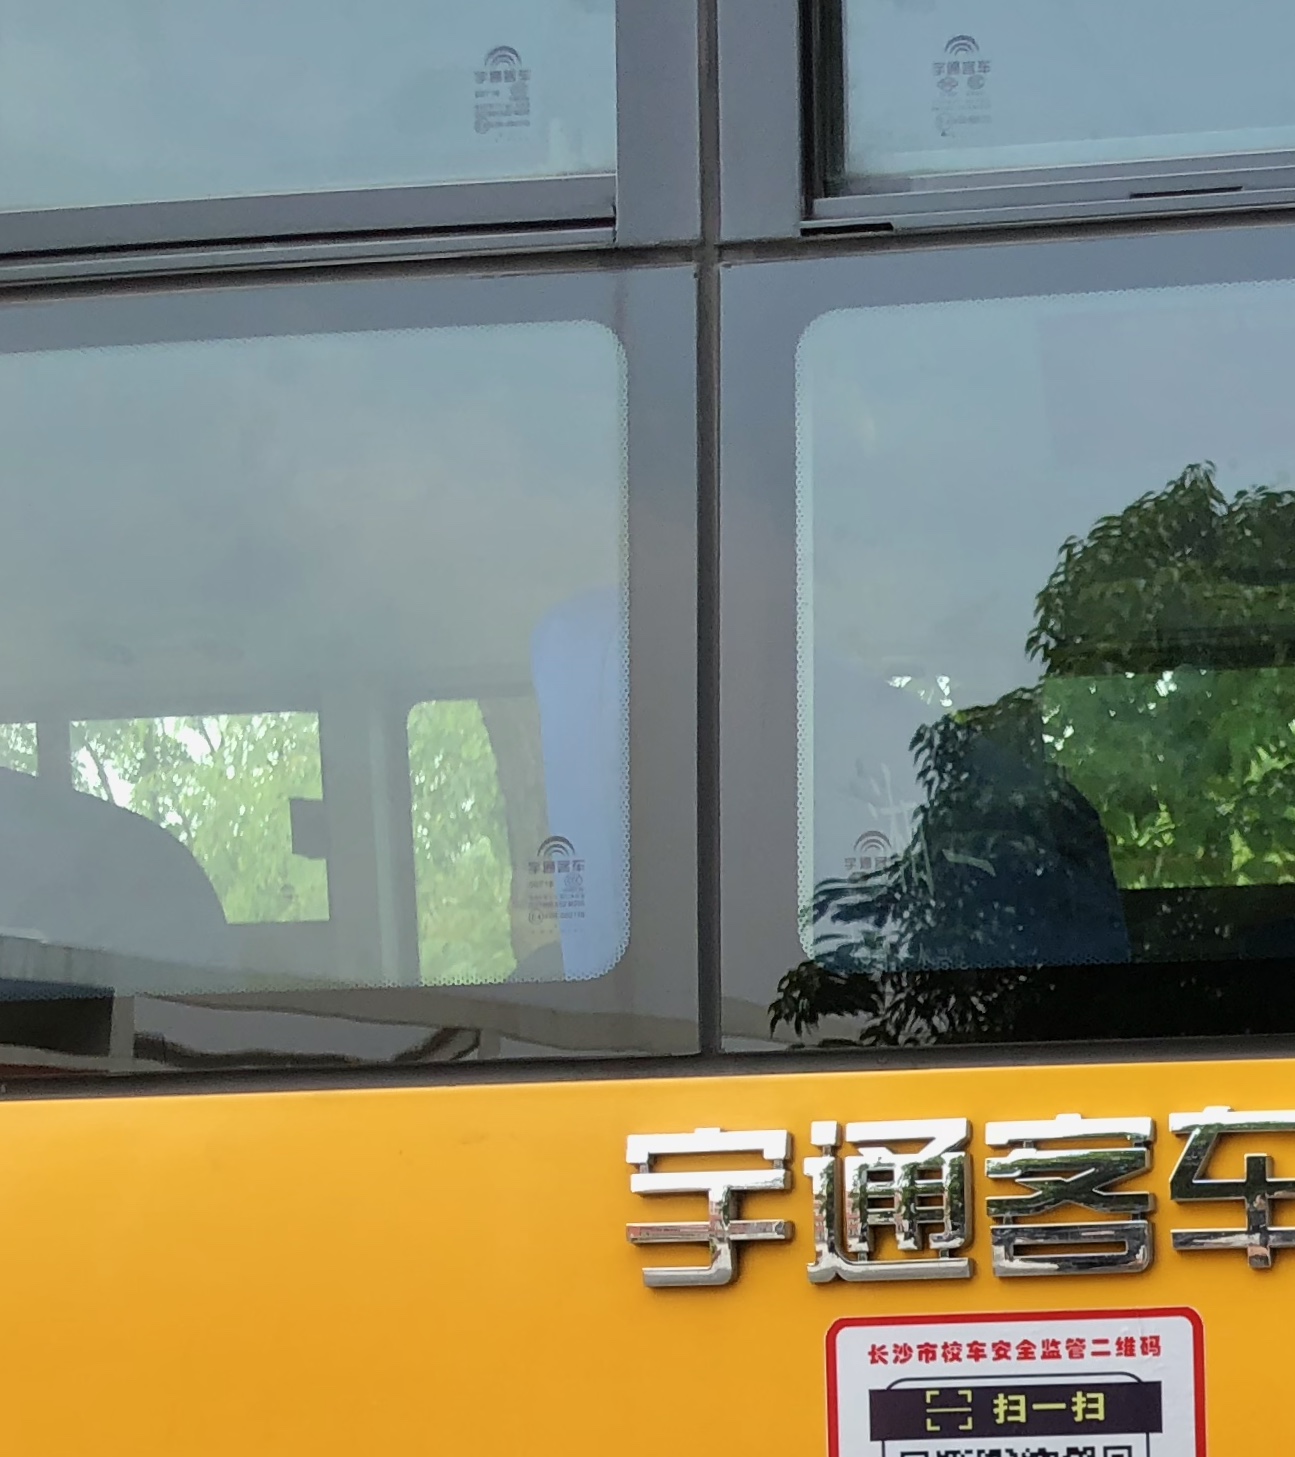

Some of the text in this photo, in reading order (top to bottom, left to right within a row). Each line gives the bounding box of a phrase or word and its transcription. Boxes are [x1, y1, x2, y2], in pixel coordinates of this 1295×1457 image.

[868, 1335, 1162, 1366] 长沙市校车安全监管二维码
[993, 1391, 1105, 1424] 扫一扫
